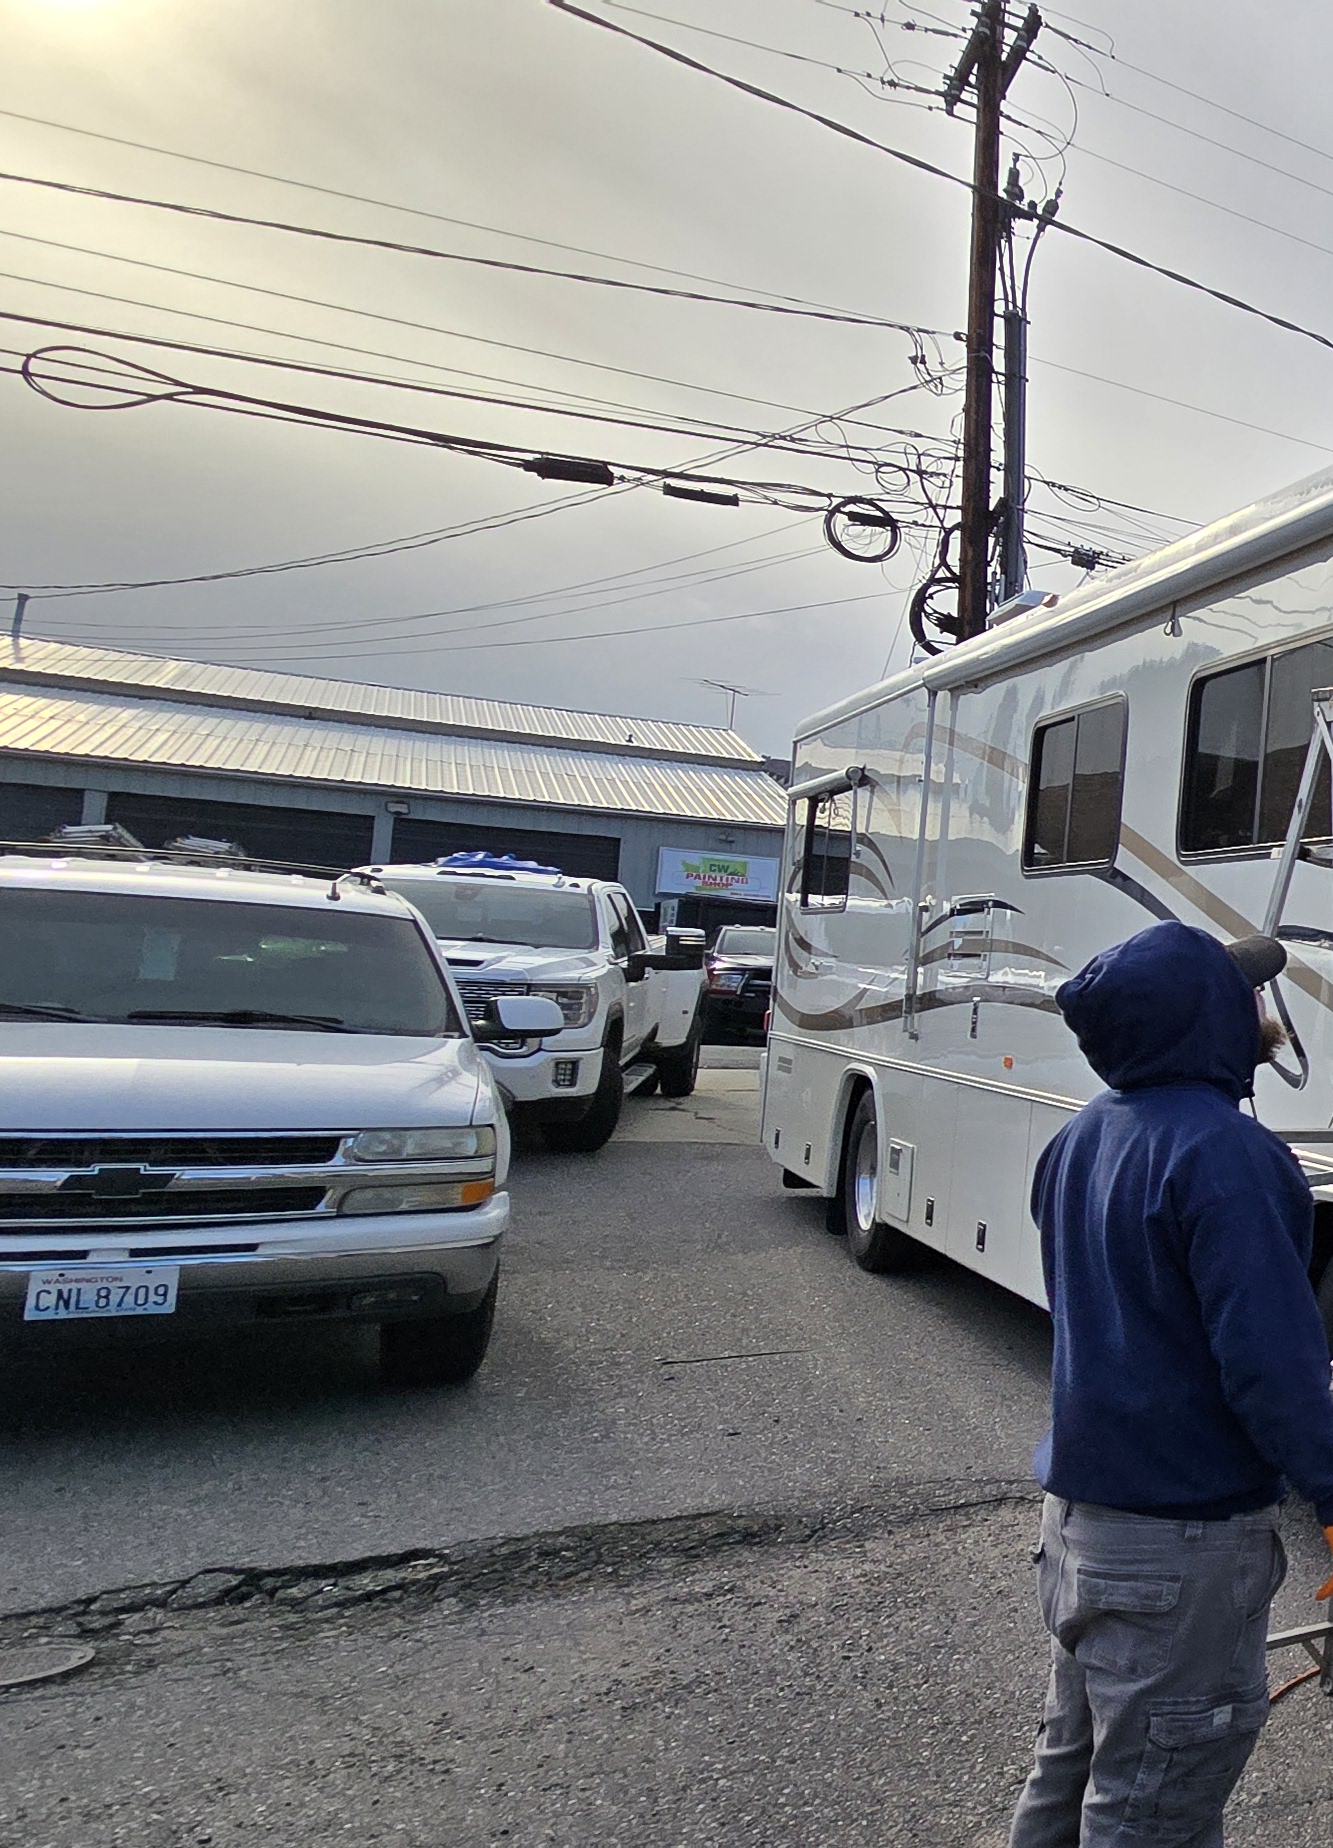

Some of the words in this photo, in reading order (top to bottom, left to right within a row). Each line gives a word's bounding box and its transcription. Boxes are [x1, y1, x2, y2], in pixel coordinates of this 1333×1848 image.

[709, 863, 731, 873] CW
[685, 872, 749, 885] PAINTING
[41, 1275, 124, 1285] WASHINGTON
[34, 1283, 170, 1312] CNL8709
